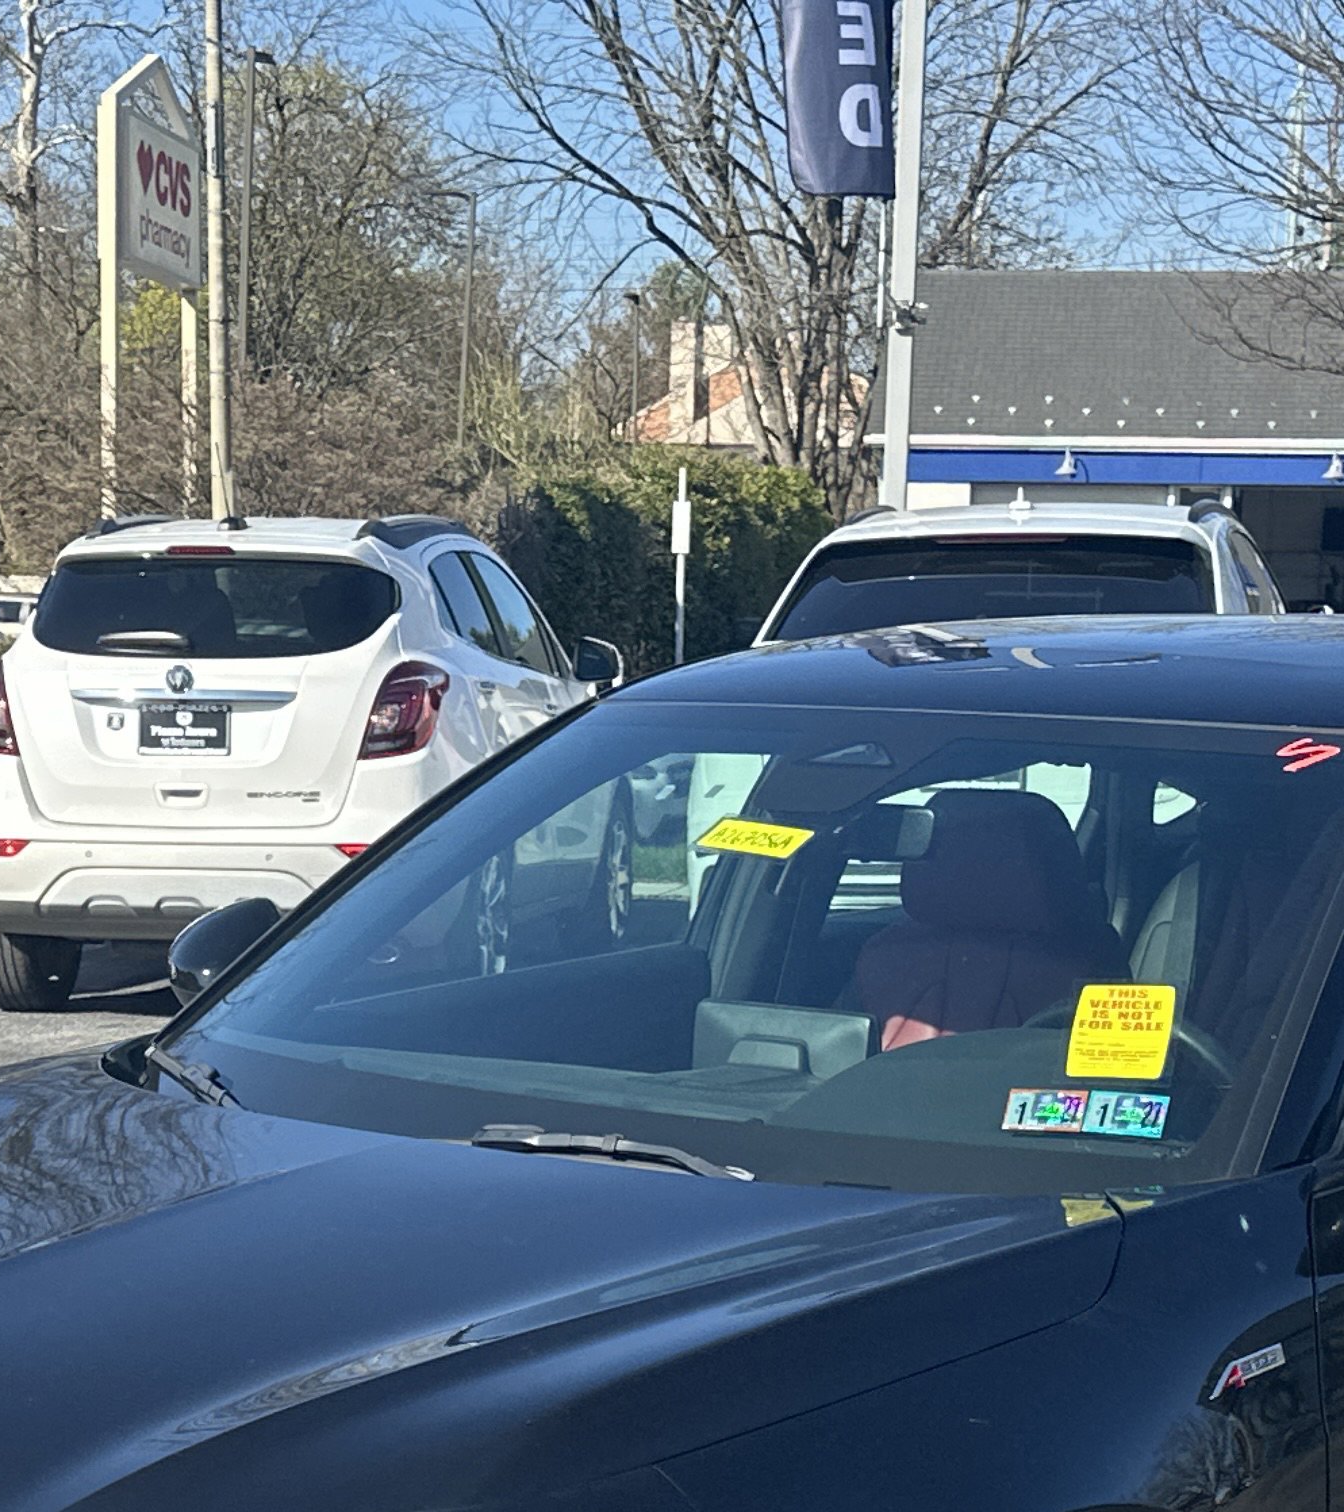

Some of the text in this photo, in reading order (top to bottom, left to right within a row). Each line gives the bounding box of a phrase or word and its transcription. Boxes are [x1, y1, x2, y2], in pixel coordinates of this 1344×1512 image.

[155, 150, 192, 218] CVS
[139, 208, 192, 269] pharmacy
[1108, 988, 1148, 998] THIS
[1090, 999, 1163, 1010] VEHICLE
[1092, 1009, 1155, 1020] IS NOT
[1078, 1019, 1164, 1032] FOR SALE
